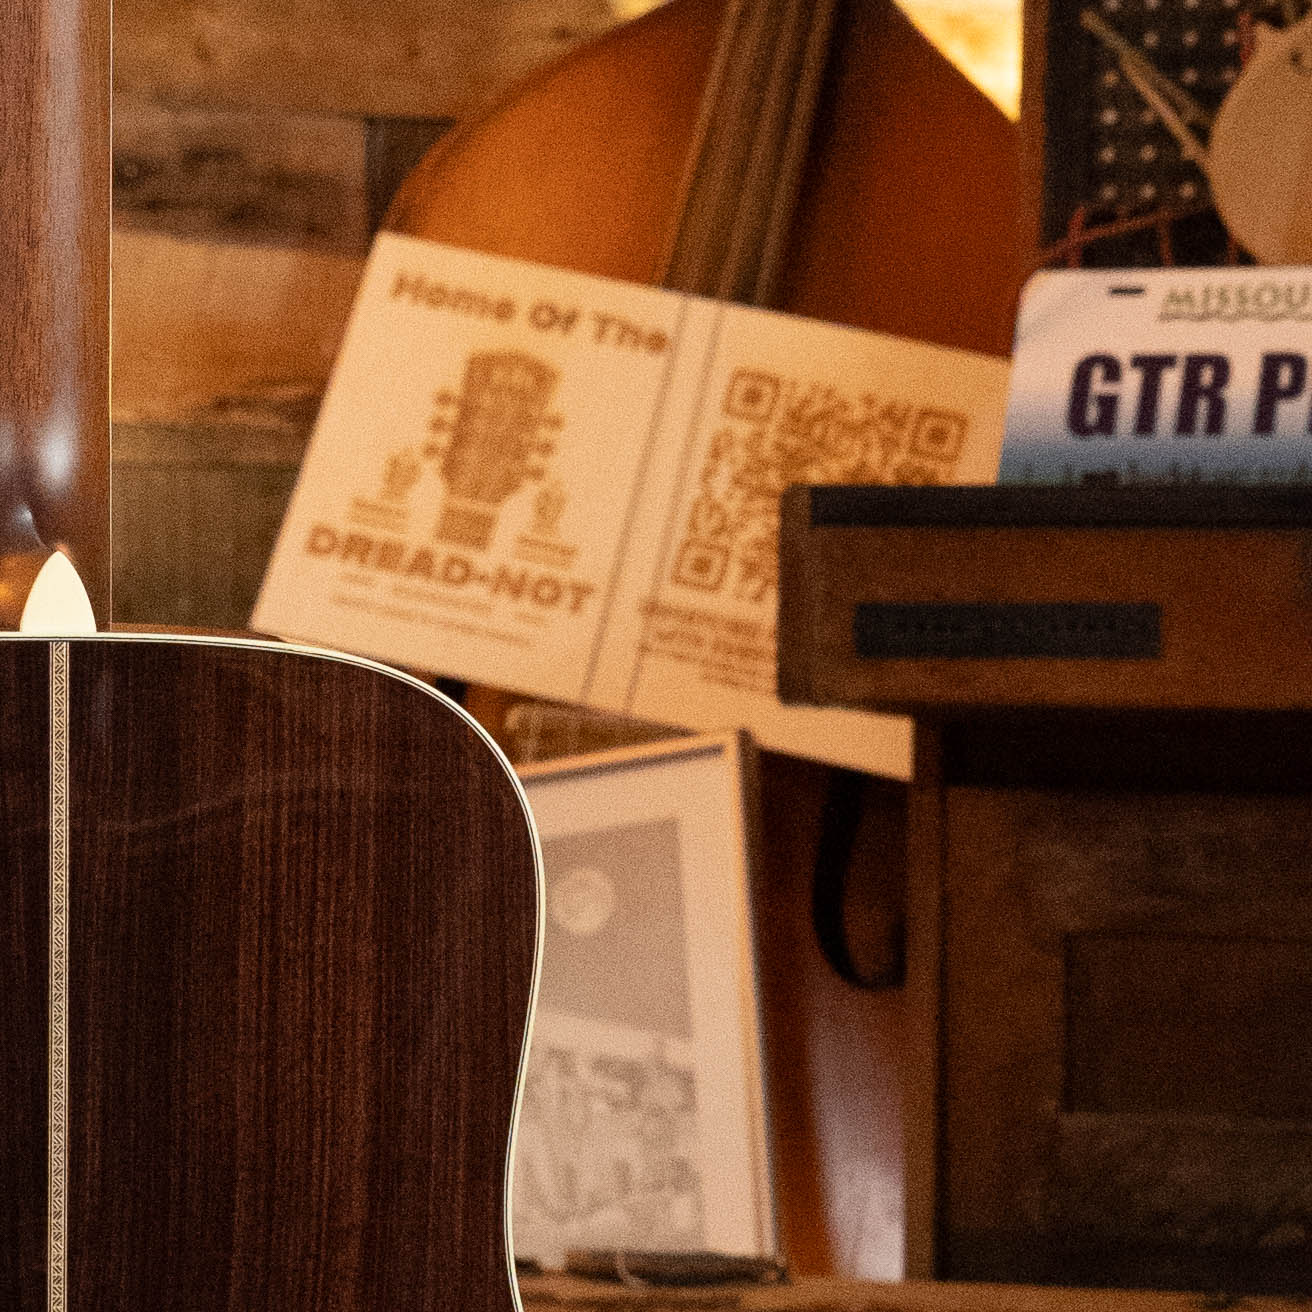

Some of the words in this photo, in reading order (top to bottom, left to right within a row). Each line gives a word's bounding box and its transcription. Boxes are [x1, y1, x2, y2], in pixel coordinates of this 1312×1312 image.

[390, 268, 517, 323] Home
[528, 300, 580, 334] Of
[593, 309, 671, 355] The
[1066, 352, 1233, 438] GTR
[304, 520, 595, 615] DREAD-NOT
